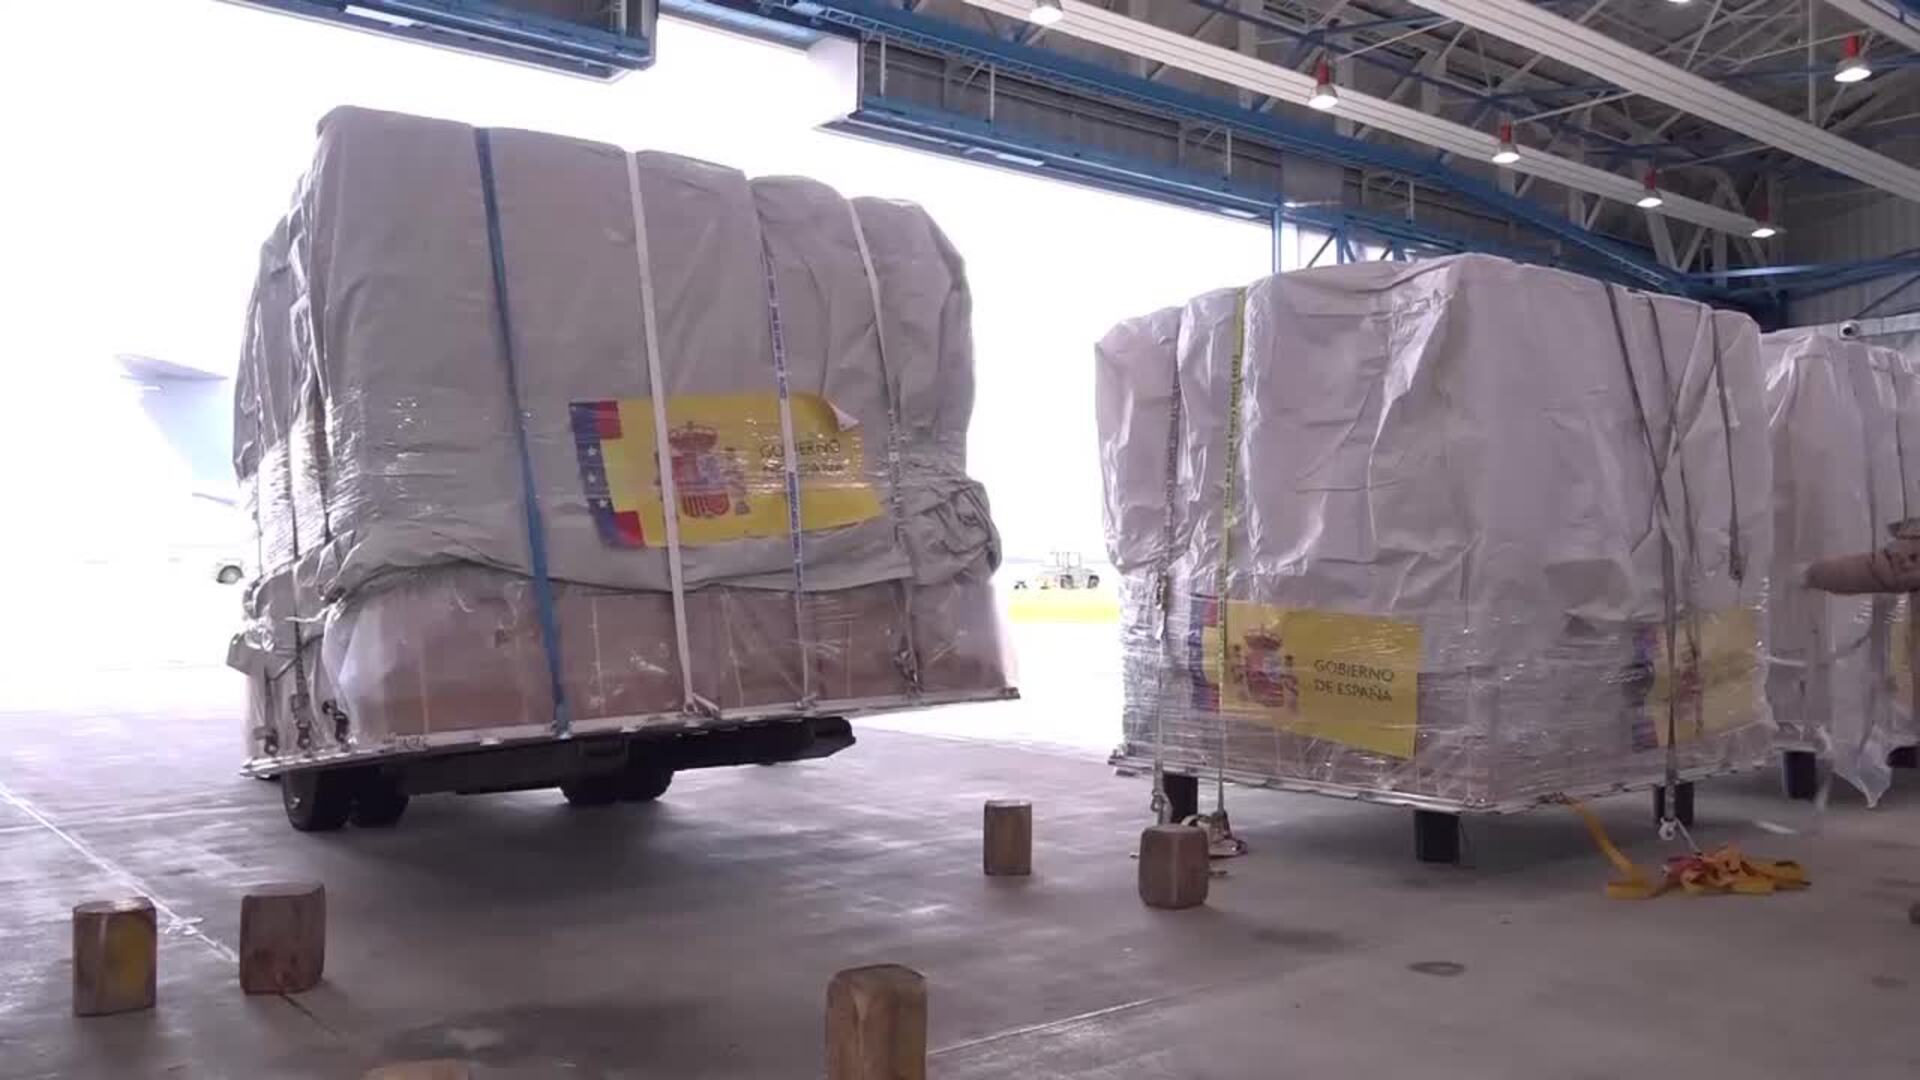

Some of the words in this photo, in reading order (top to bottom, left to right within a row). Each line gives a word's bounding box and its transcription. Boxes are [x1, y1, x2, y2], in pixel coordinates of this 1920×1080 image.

[1314, 659, 1394, 682] GOBIERNO
[1314, 679, 1332, 695] DE
[1337, 682, 1392, 702] ESPAÑA
